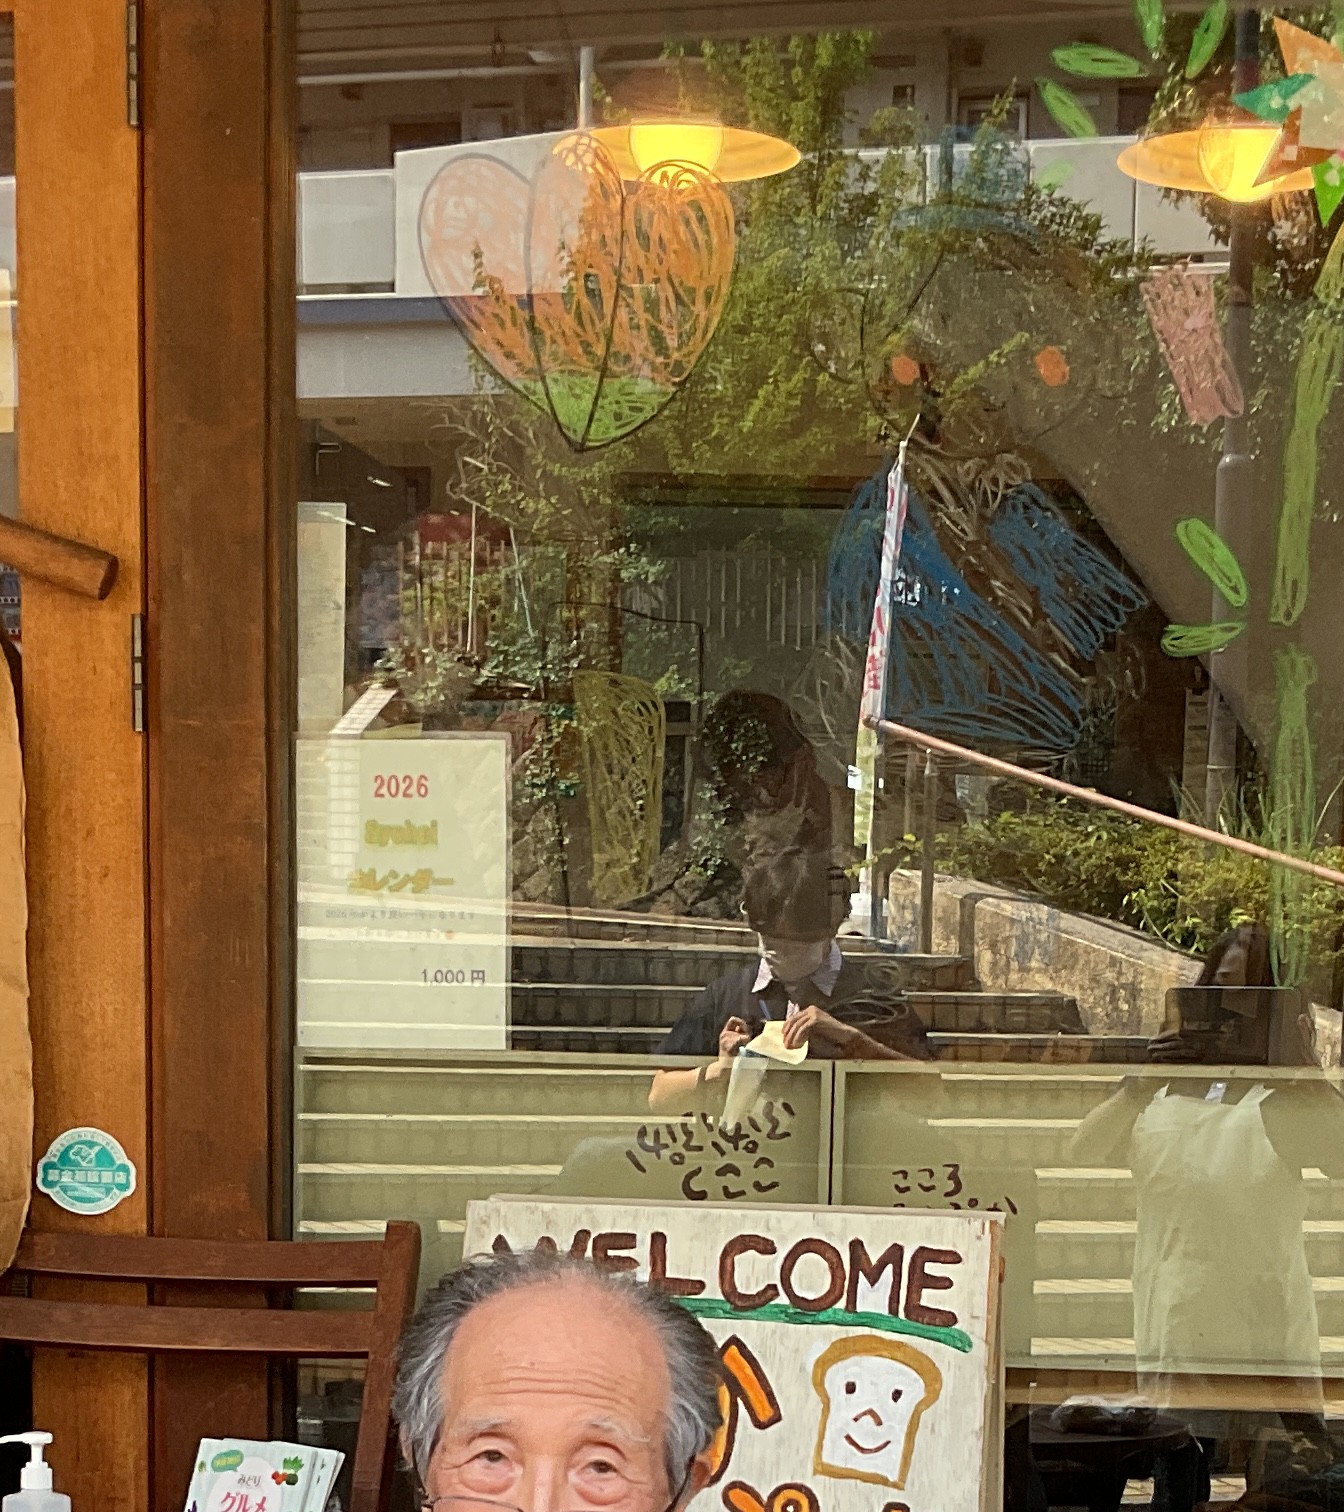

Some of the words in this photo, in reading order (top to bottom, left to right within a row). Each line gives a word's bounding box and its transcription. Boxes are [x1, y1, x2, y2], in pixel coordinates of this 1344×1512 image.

[374, 774, 429, 798] 2026
[237, 1474, 261, 1487] みどり
